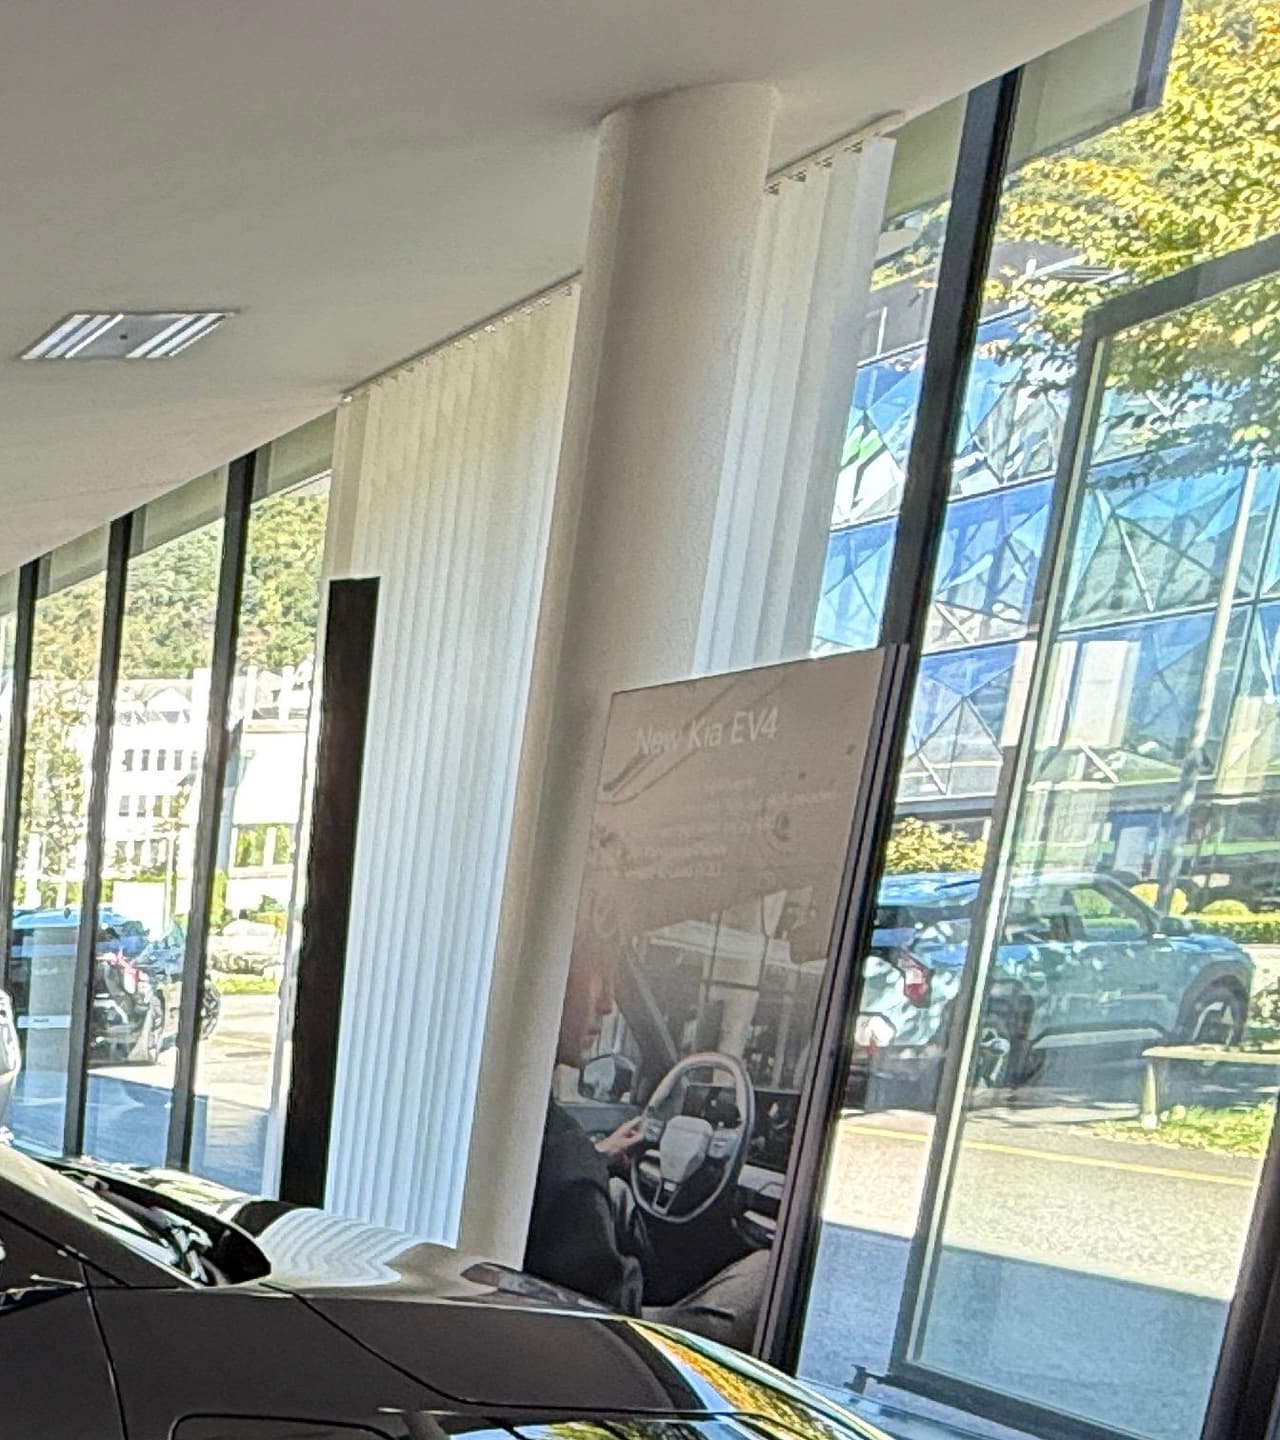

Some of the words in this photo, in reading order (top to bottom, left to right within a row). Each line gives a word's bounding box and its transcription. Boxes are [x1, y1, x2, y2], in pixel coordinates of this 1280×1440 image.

[637, 721, 682, 753] New
[688, 716, 723, 749] Kia
[731, 707, 779, 744] EV4
